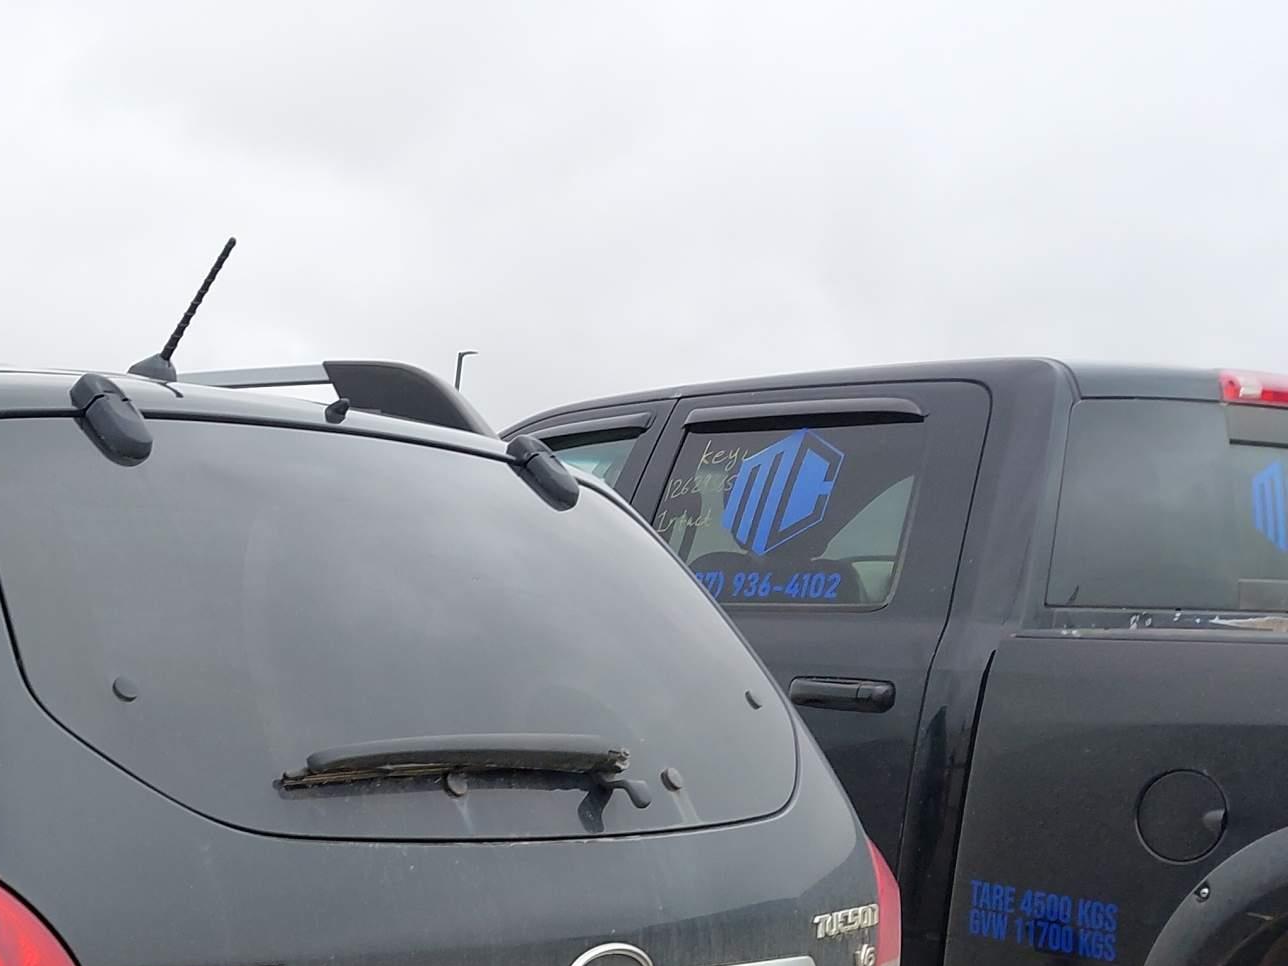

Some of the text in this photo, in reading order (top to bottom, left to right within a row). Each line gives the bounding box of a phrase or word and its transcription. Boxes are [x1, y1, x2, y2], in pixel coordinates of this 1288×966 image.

[732, 572, 841, 600] 936-4102
[970, 879, 1119, 932] TARE 4500 KGS
[969, 908, 1118, 962] GVW 11700 KGS
